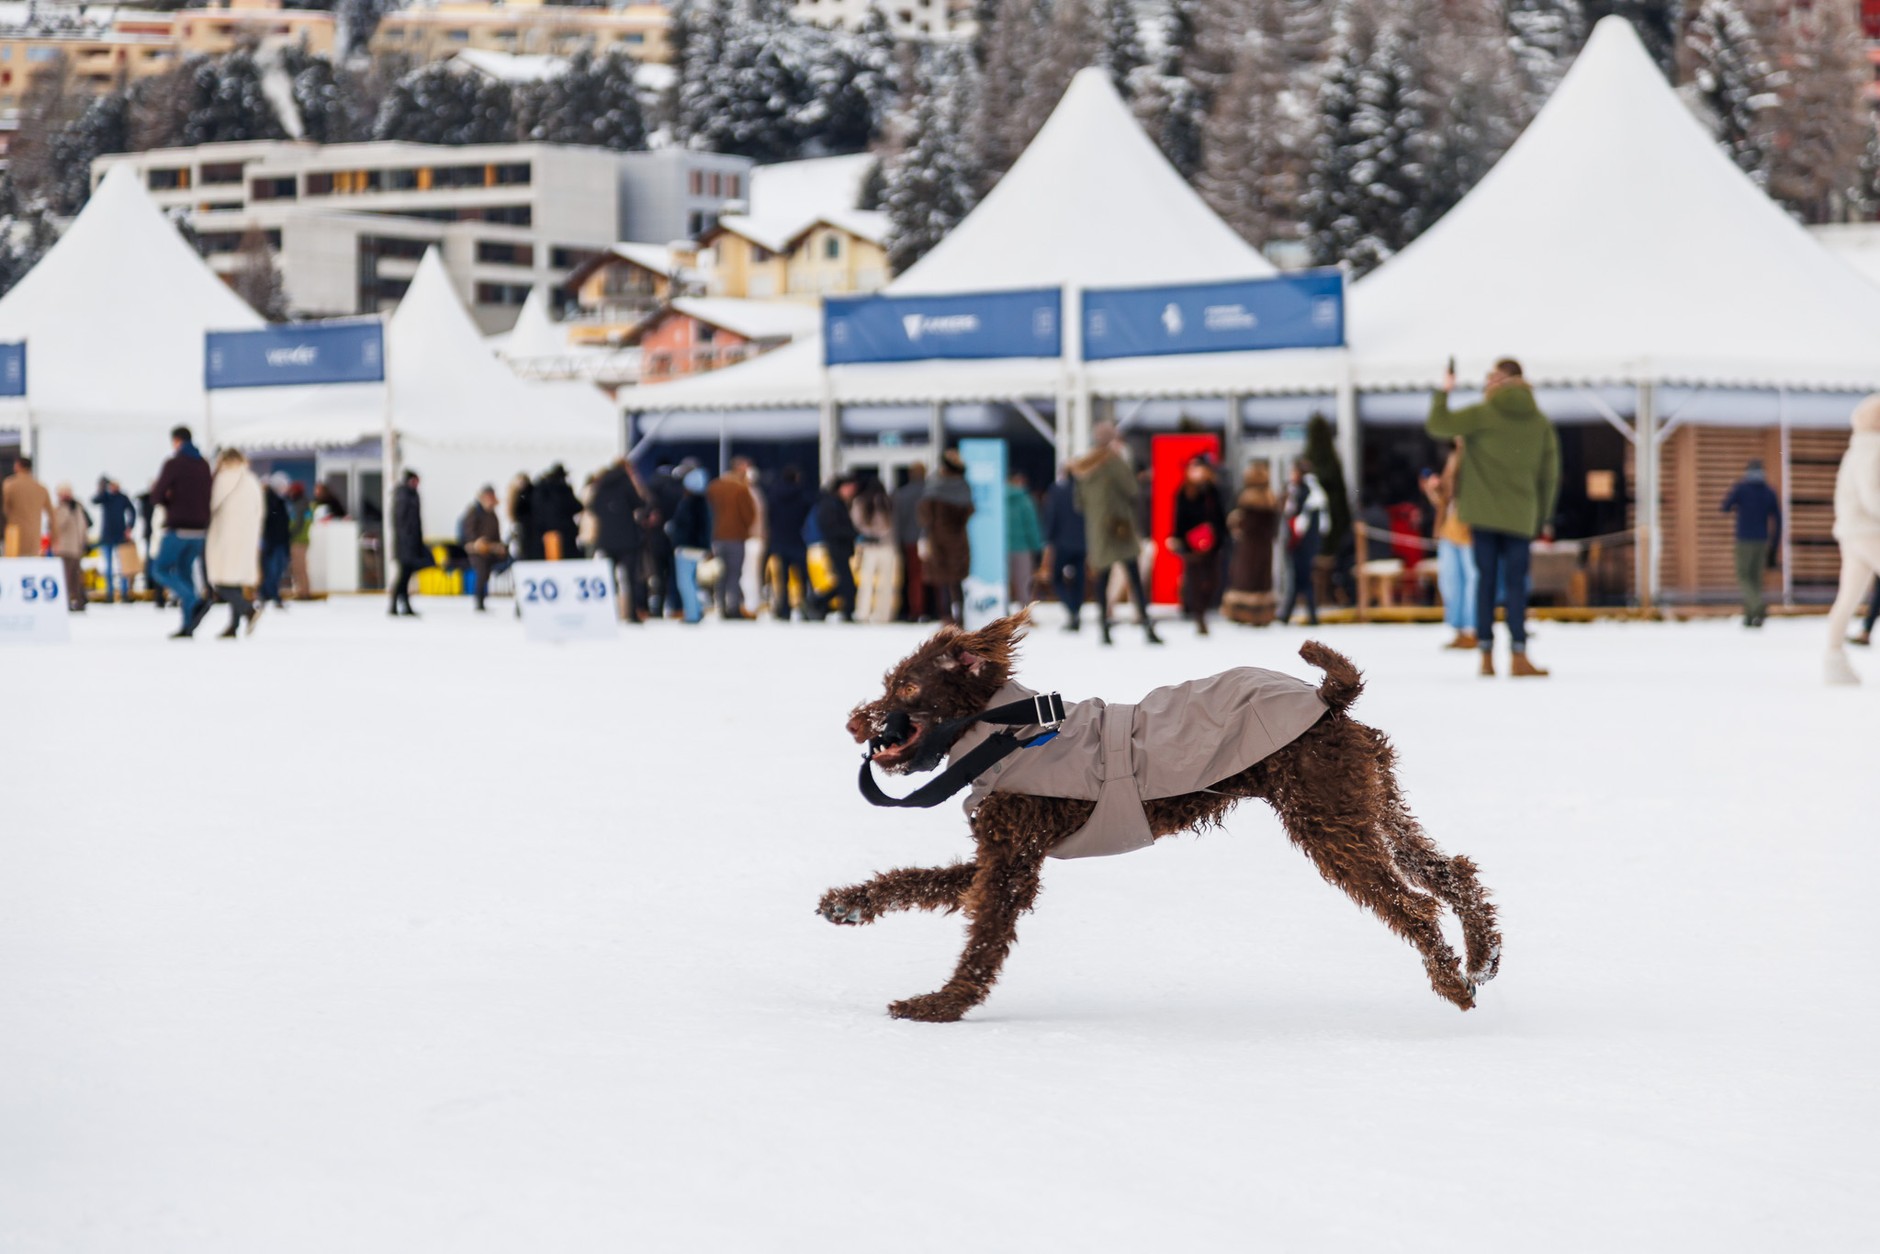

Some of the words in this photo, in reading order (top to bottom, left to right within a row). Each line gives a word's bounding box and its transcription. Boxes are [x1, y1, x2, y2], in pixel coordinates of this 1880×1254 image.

[21, 576, 59, 601] 59
[523, 579, 558, 601] 20
[574, 577, 607, 600] 39
